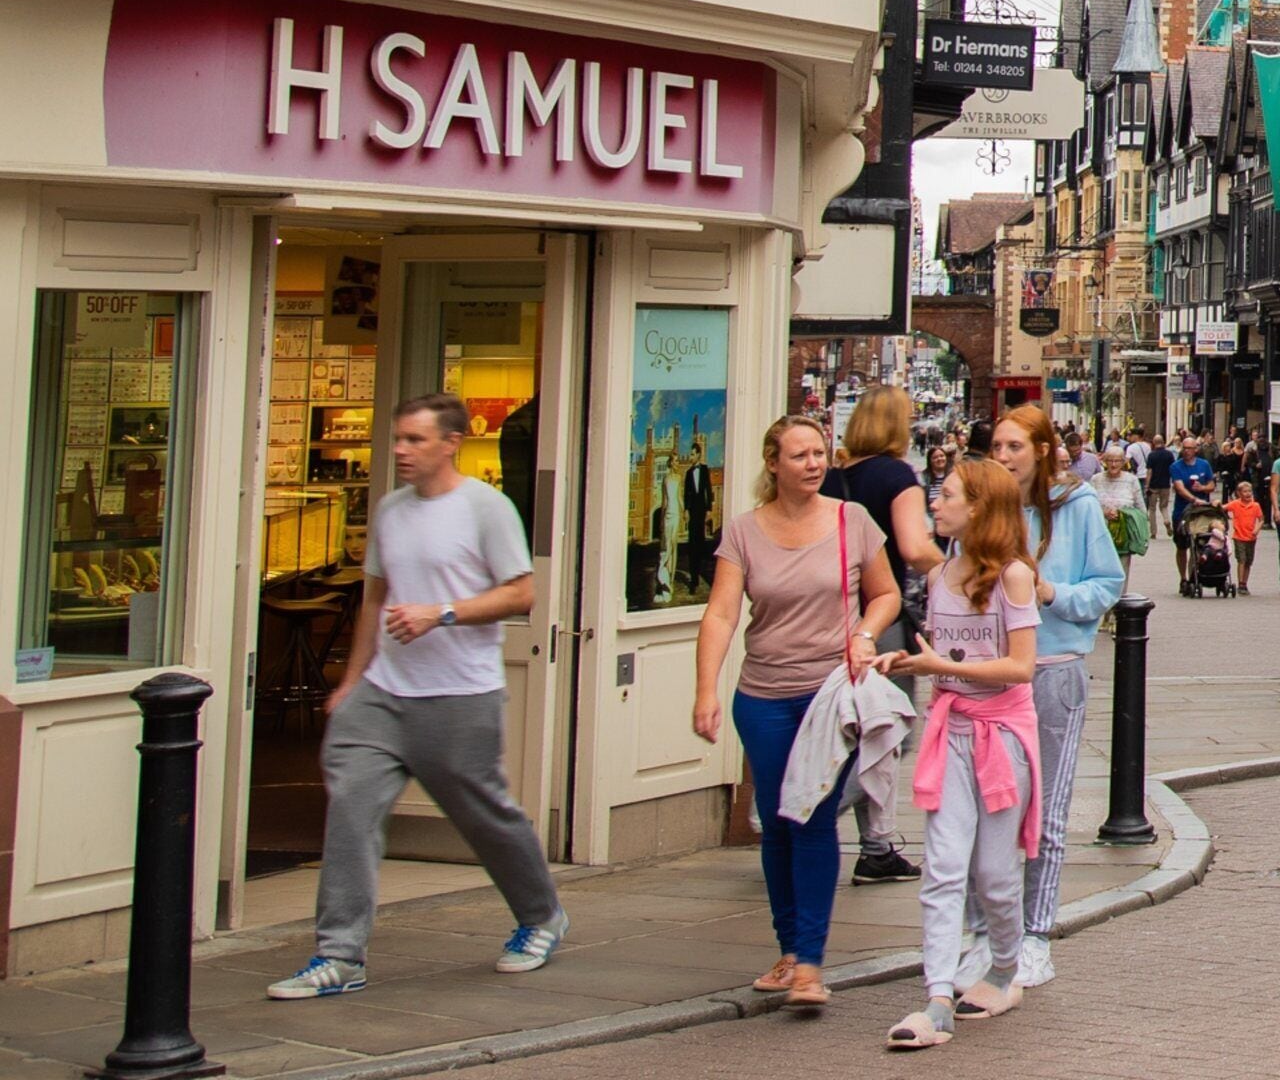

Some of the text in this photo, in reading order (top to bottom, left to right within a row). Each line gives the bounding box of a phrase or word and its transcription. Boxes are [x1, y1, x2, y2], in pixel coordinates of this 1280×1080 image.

[931, 35, 952, 53] Dr
[933, 61, 1026, 77] Tel: 01244 348205
[266, 16, 744, 180] H SAMUEL
[961, 111, 1048, 125] AVERBROOKS
[110, 295, 139, 314] OFF
[1203, 331, 1231, 340] TO LET
[934, 626, 993, 642] ONJOUR
